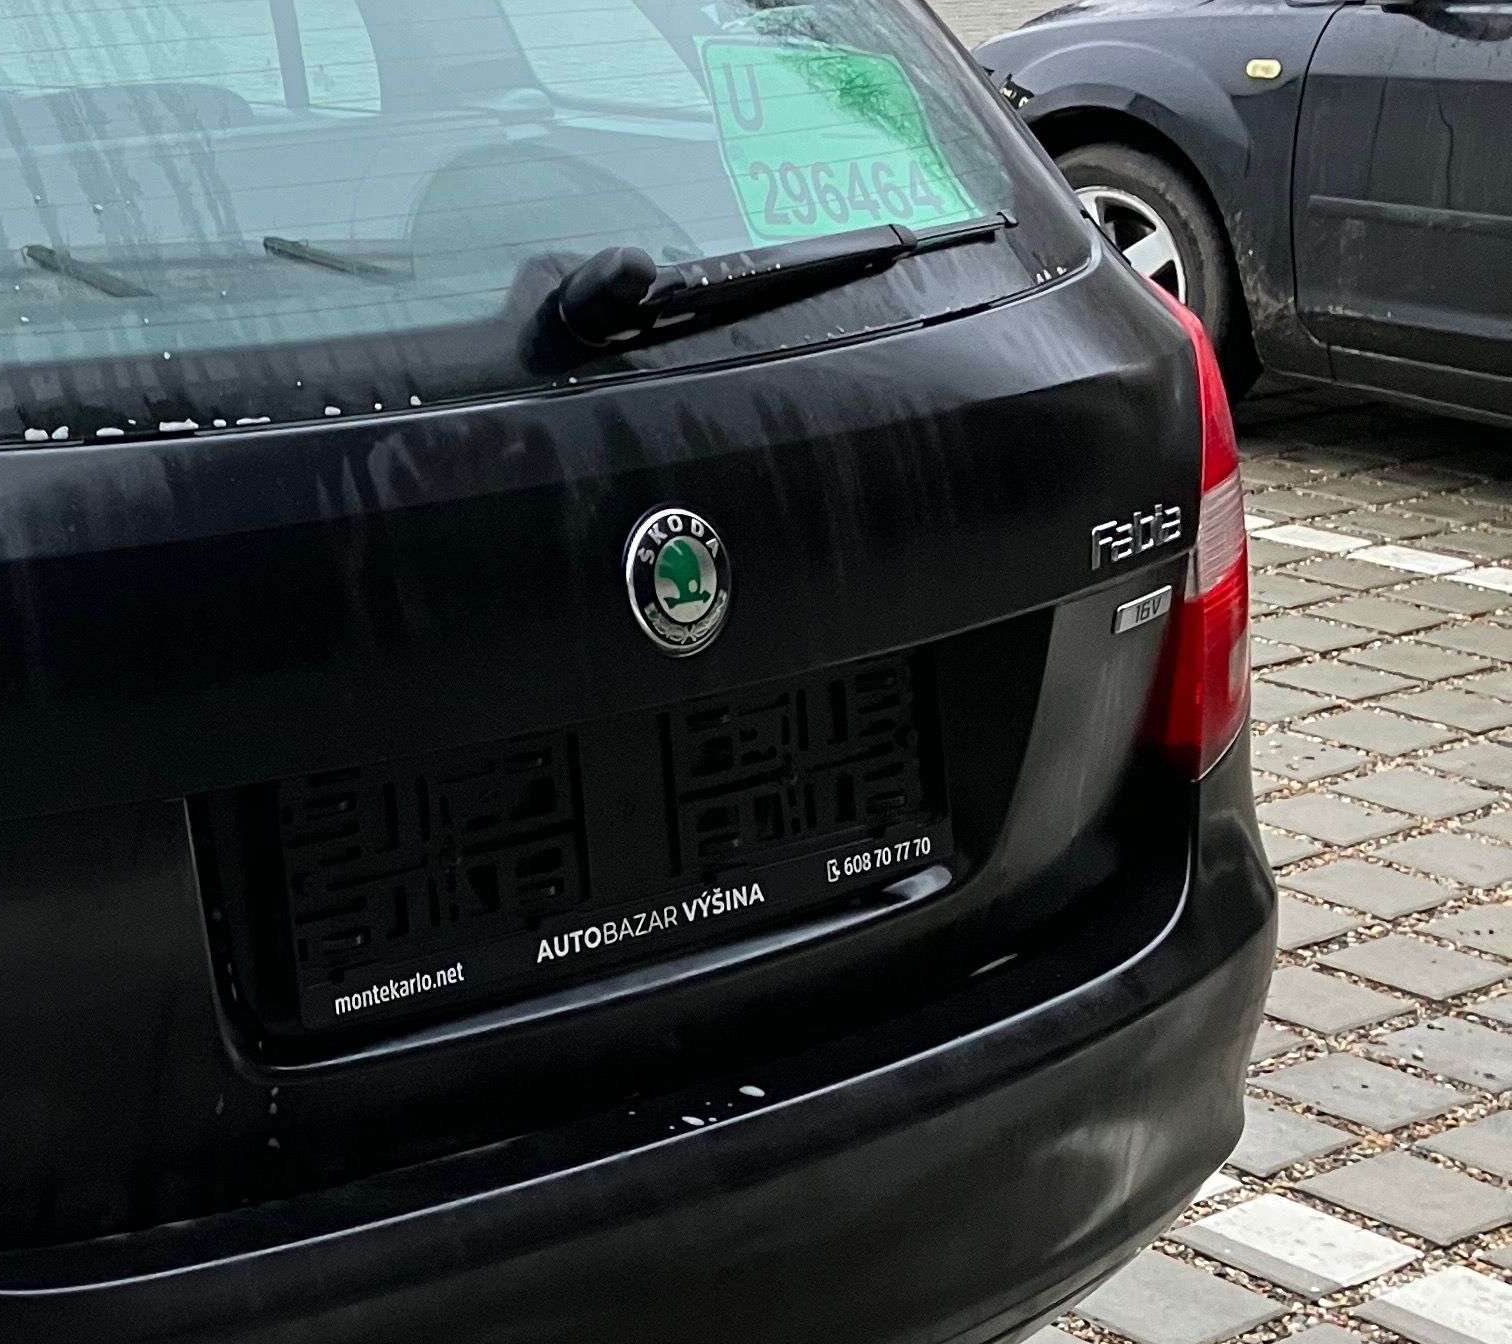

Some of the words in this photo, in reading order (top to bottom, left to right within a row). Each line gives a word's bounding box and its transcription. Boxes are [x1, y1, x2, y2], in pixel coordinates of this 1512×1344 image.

[722, 62, 764, 132] U
[750, 162, 946, 224] 296464
[1134, 596, 1162, 624] 16V
[844, 853, 871, 875] 608
[874, 847, 891, 867] 70
[894, 841, 910, 862] 77
[913, 837, 930, 856] 70
[536, 905, 678, 964] AUTOBAZAR
[682, 882, 765, 922] VÝŠINA
[334, 961, 465, 1016] montekarlo.net
